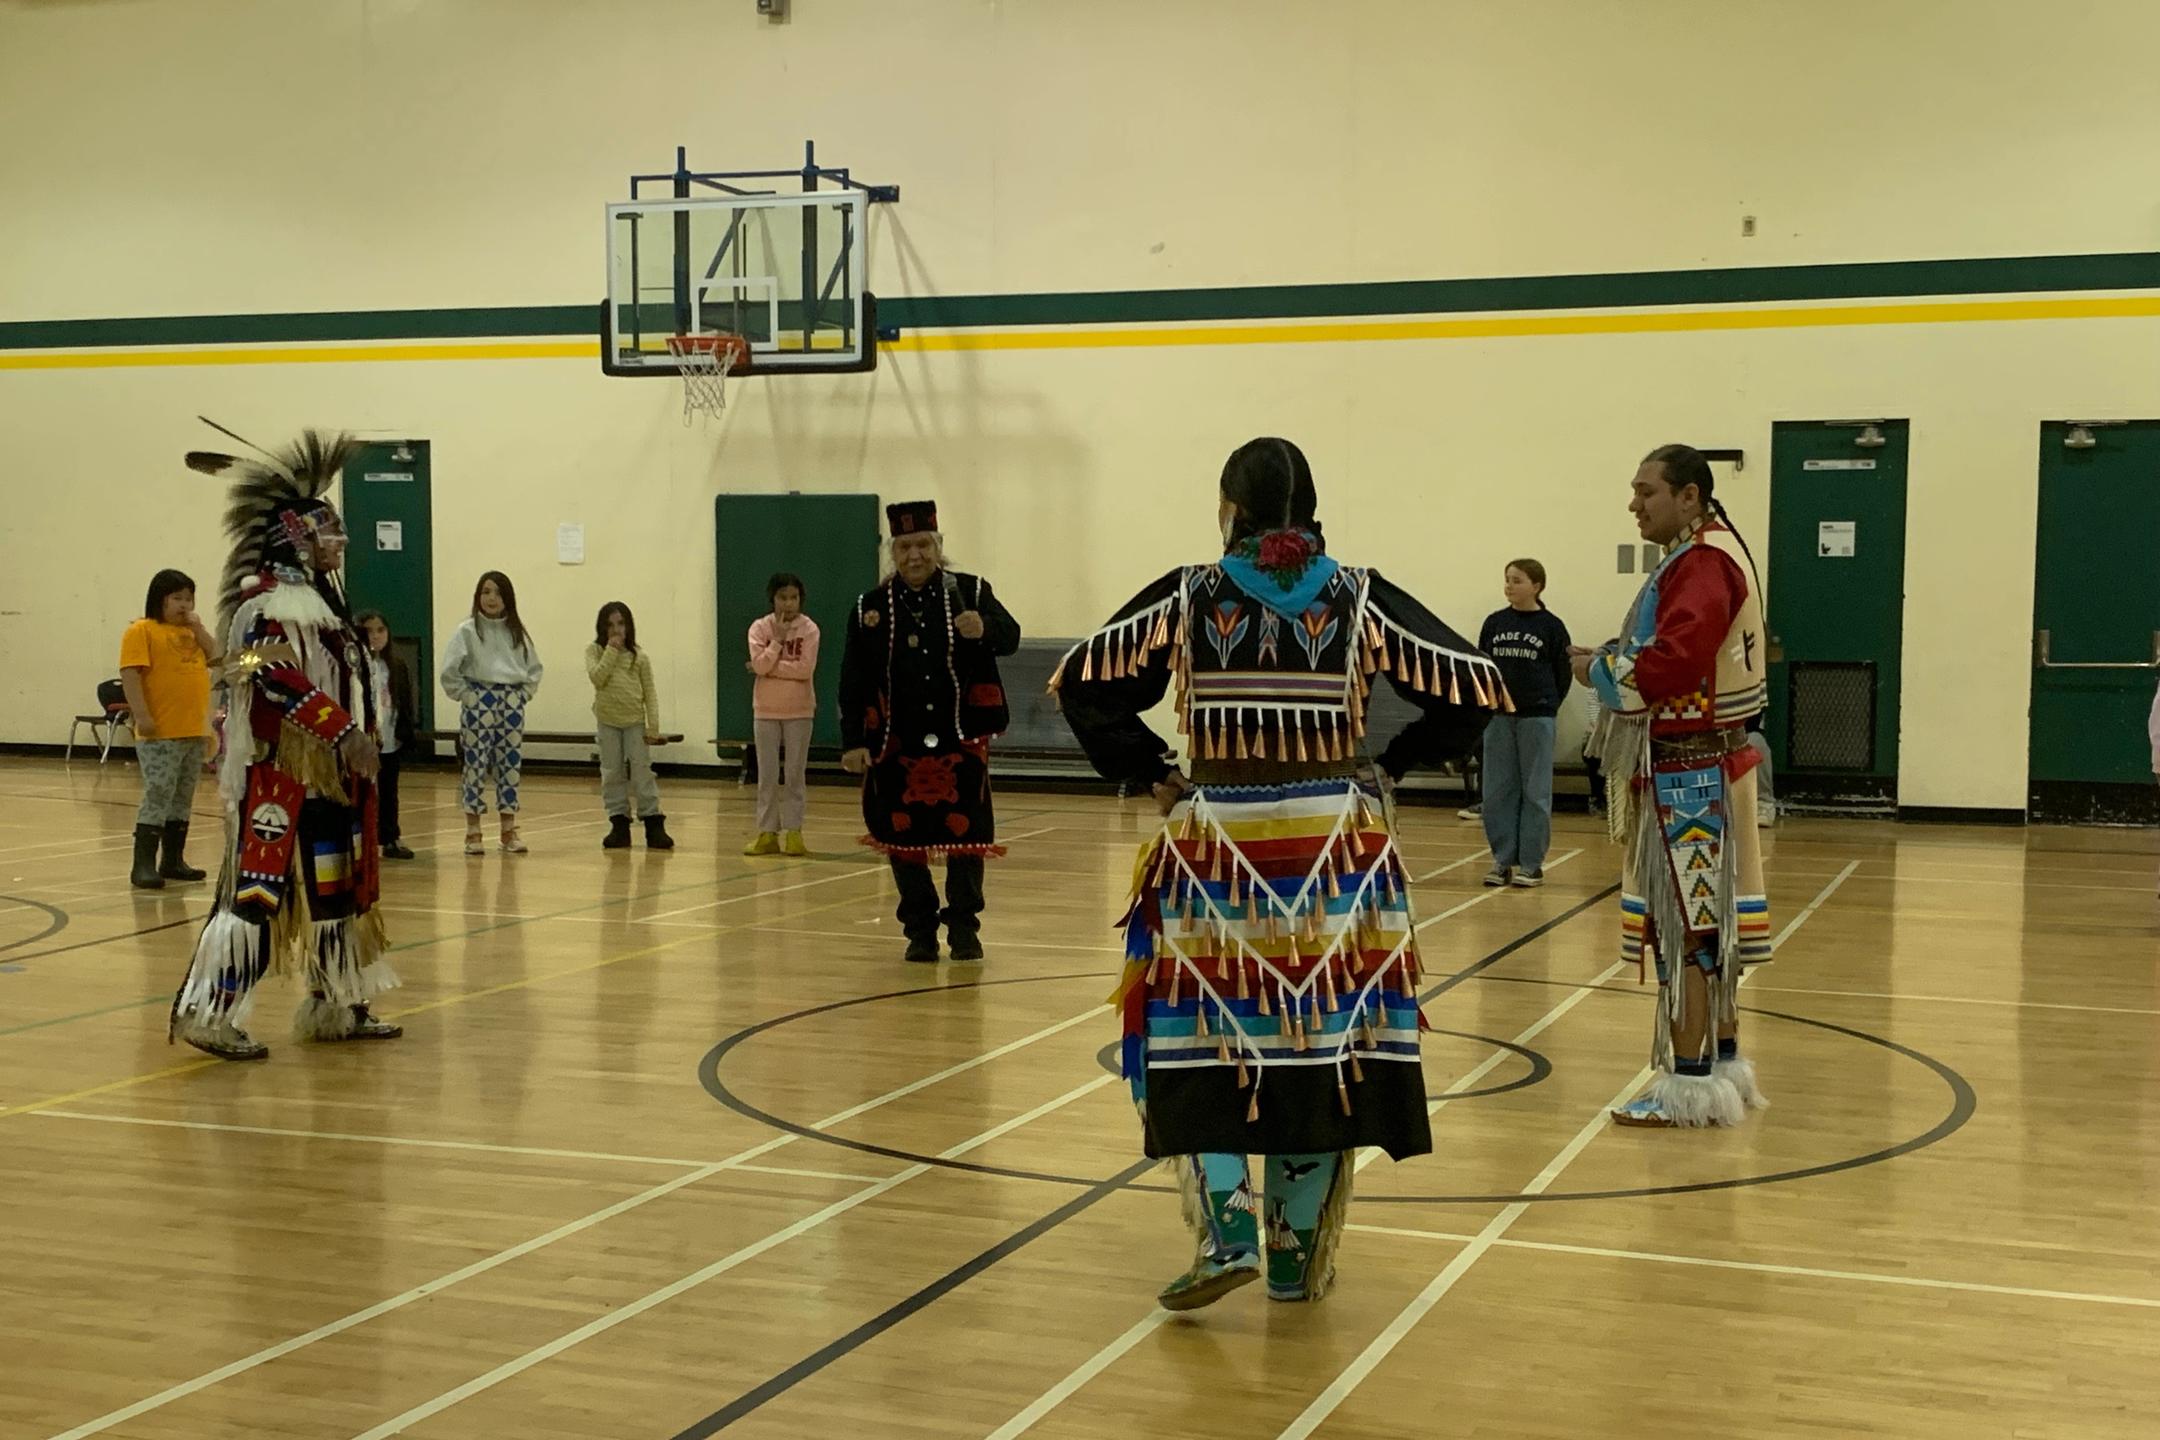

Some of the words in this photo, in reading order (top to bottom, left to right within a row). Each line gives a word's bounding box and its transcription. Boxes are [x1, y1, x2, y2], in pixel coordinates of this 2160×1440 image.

[1492, 631, 1520, 644] MADE
[1523, 633, 1543, 648] FOR
[1492, 647, 1537, 660] RUNNING
